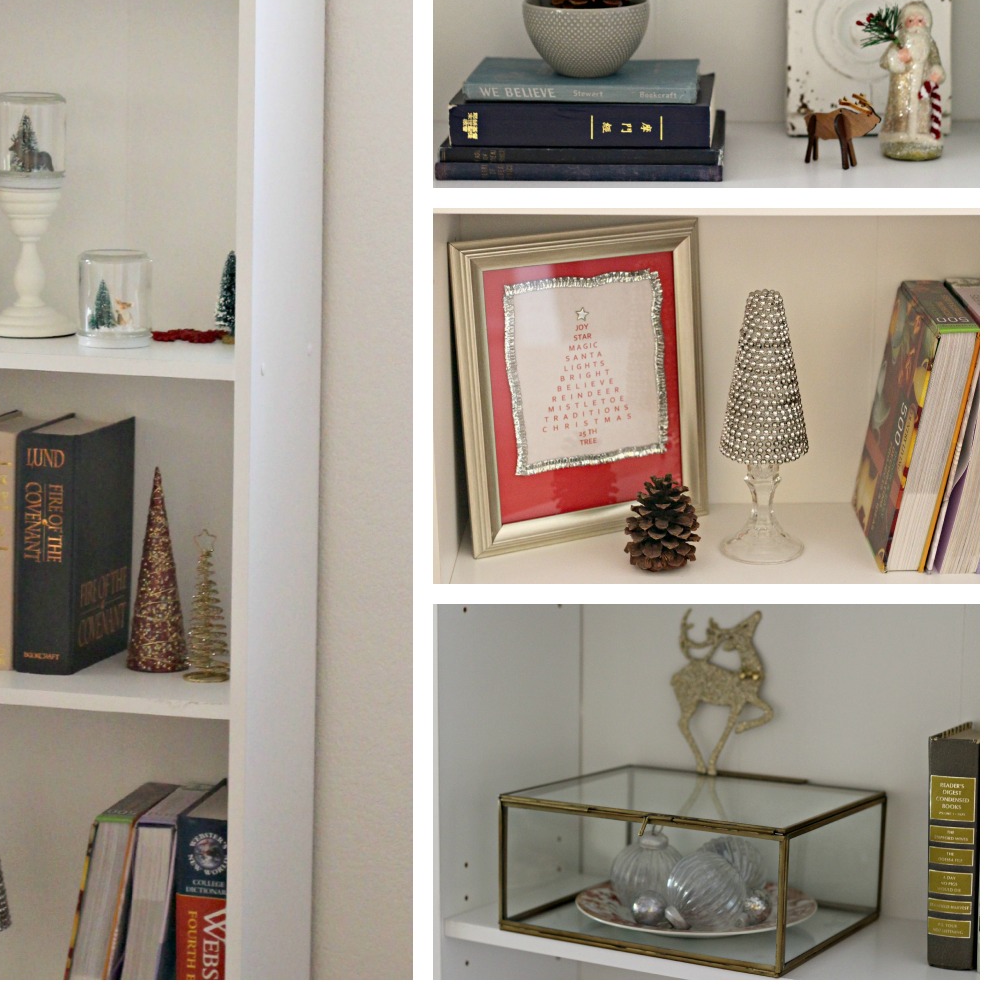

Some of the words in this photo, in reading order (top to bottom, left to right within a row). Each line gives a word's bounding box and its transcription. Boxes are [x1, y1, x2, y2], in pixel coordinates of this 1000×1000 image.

[479, 86, 500, 98] WE
[505, 87, 556, 98] BELIEVE
[573, 89, 603, 97] Stewart
[639, 91, 678, 100] Bookcraft
[602, 122, 652, 133] 摩門經
[575, 323, 589, 331] JOY
[573, 333, 592, 341] STAR
[569, 342, 598, 351] MAGIC
[565, 352, 602, 362] SANTA
[564, 360, 605, 371] LIGHTS
[560, 369, 610, 382] BRIGHT
[557, 378, 613, 392] BELIEVE
[552, 387, 620, 402] REINDEER
[548, 395, 624, 412] MISTLETOE
[544, 404, 629, 422] TRADITIONS
[542, 413, 632, 433] CHRISTMAS
[894, 402, 908, 445] 500
[580, 437, 597, 445] TREE
[27, 448, 65, 468] LUND
[48, 484, 63, 512] FIRE
[24, 482, 42, 563] COVENANT
[48, 514, 63, 533] OF
[47, 535, 62, 563] THE
[186, 886, 227, 895] DICTIONAR
[186, 911, 198, 968] FOURTH
